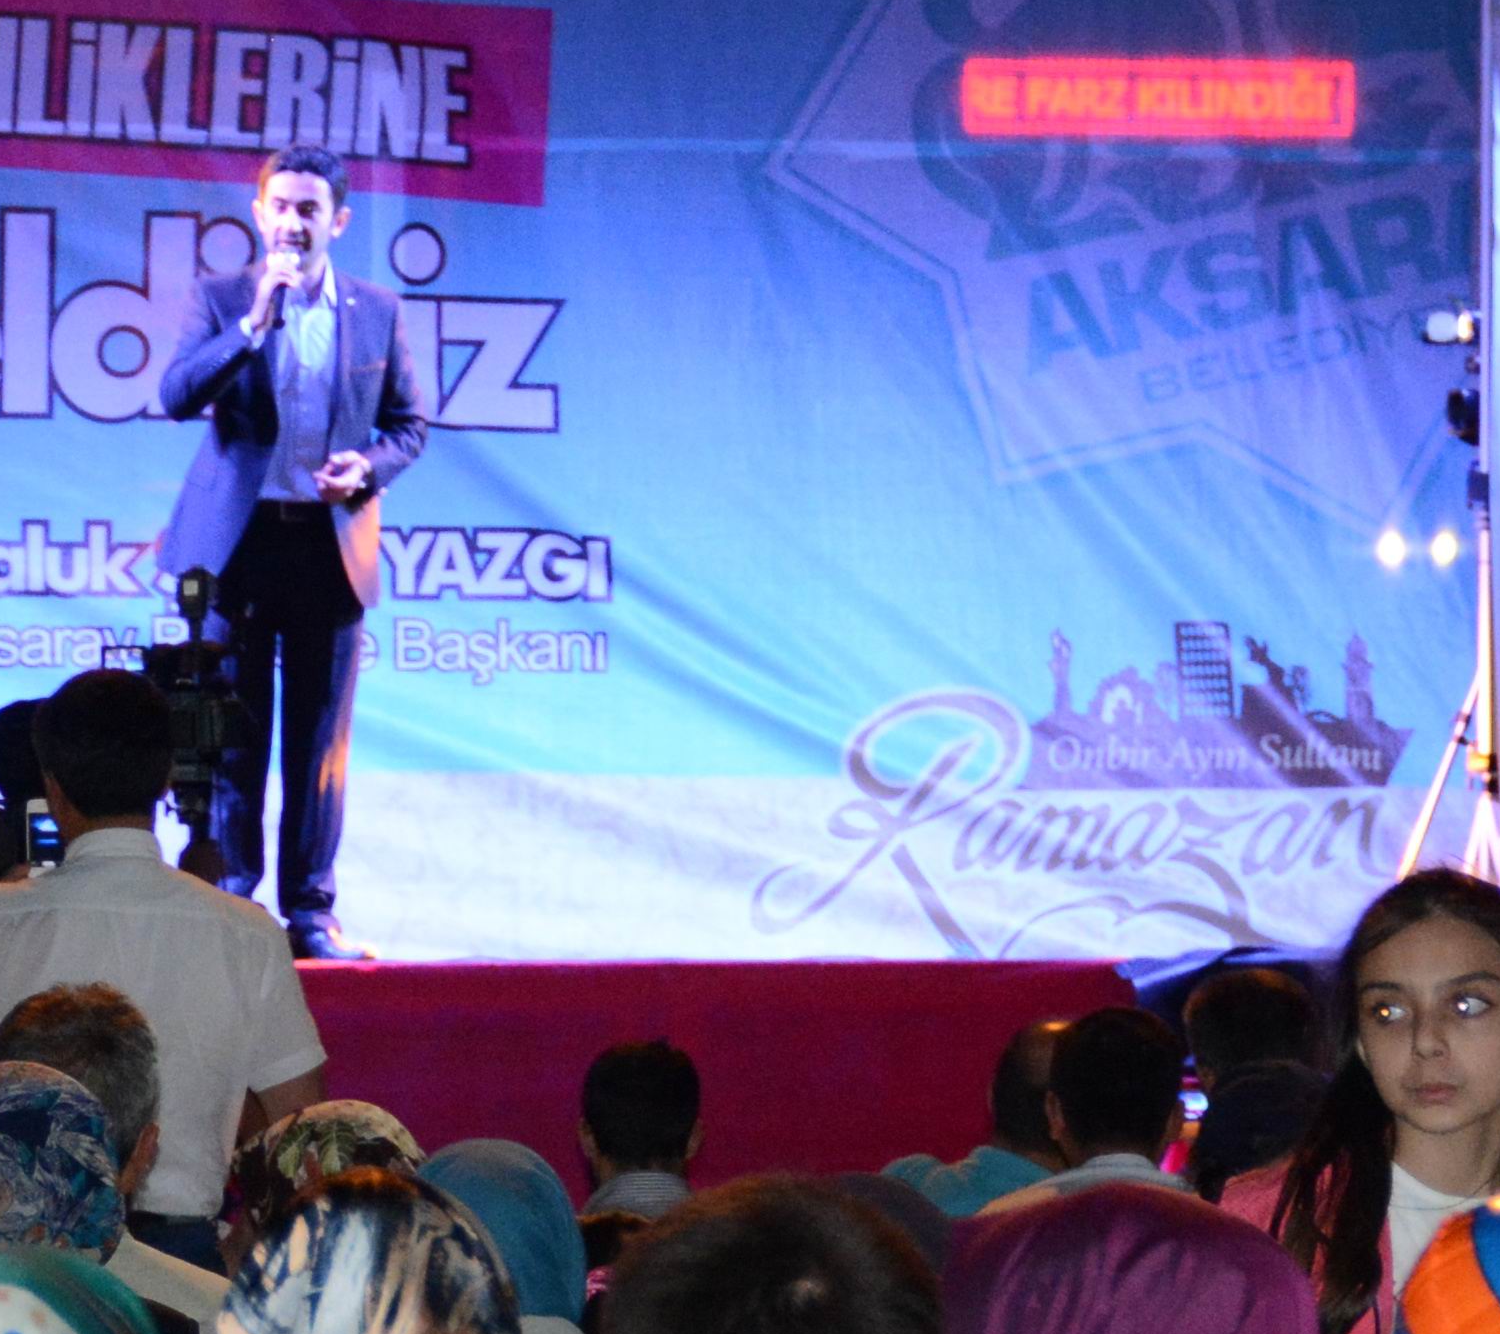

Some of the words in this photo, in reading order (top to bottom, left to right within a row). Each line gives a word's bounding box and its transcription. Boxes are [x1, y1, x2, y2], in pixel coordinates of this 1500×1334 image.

[380, 526, 612, 601] YAZGI
[394, 617, 608, 685] Başkanı
[1049, 734, 1151, 773] Onbir
